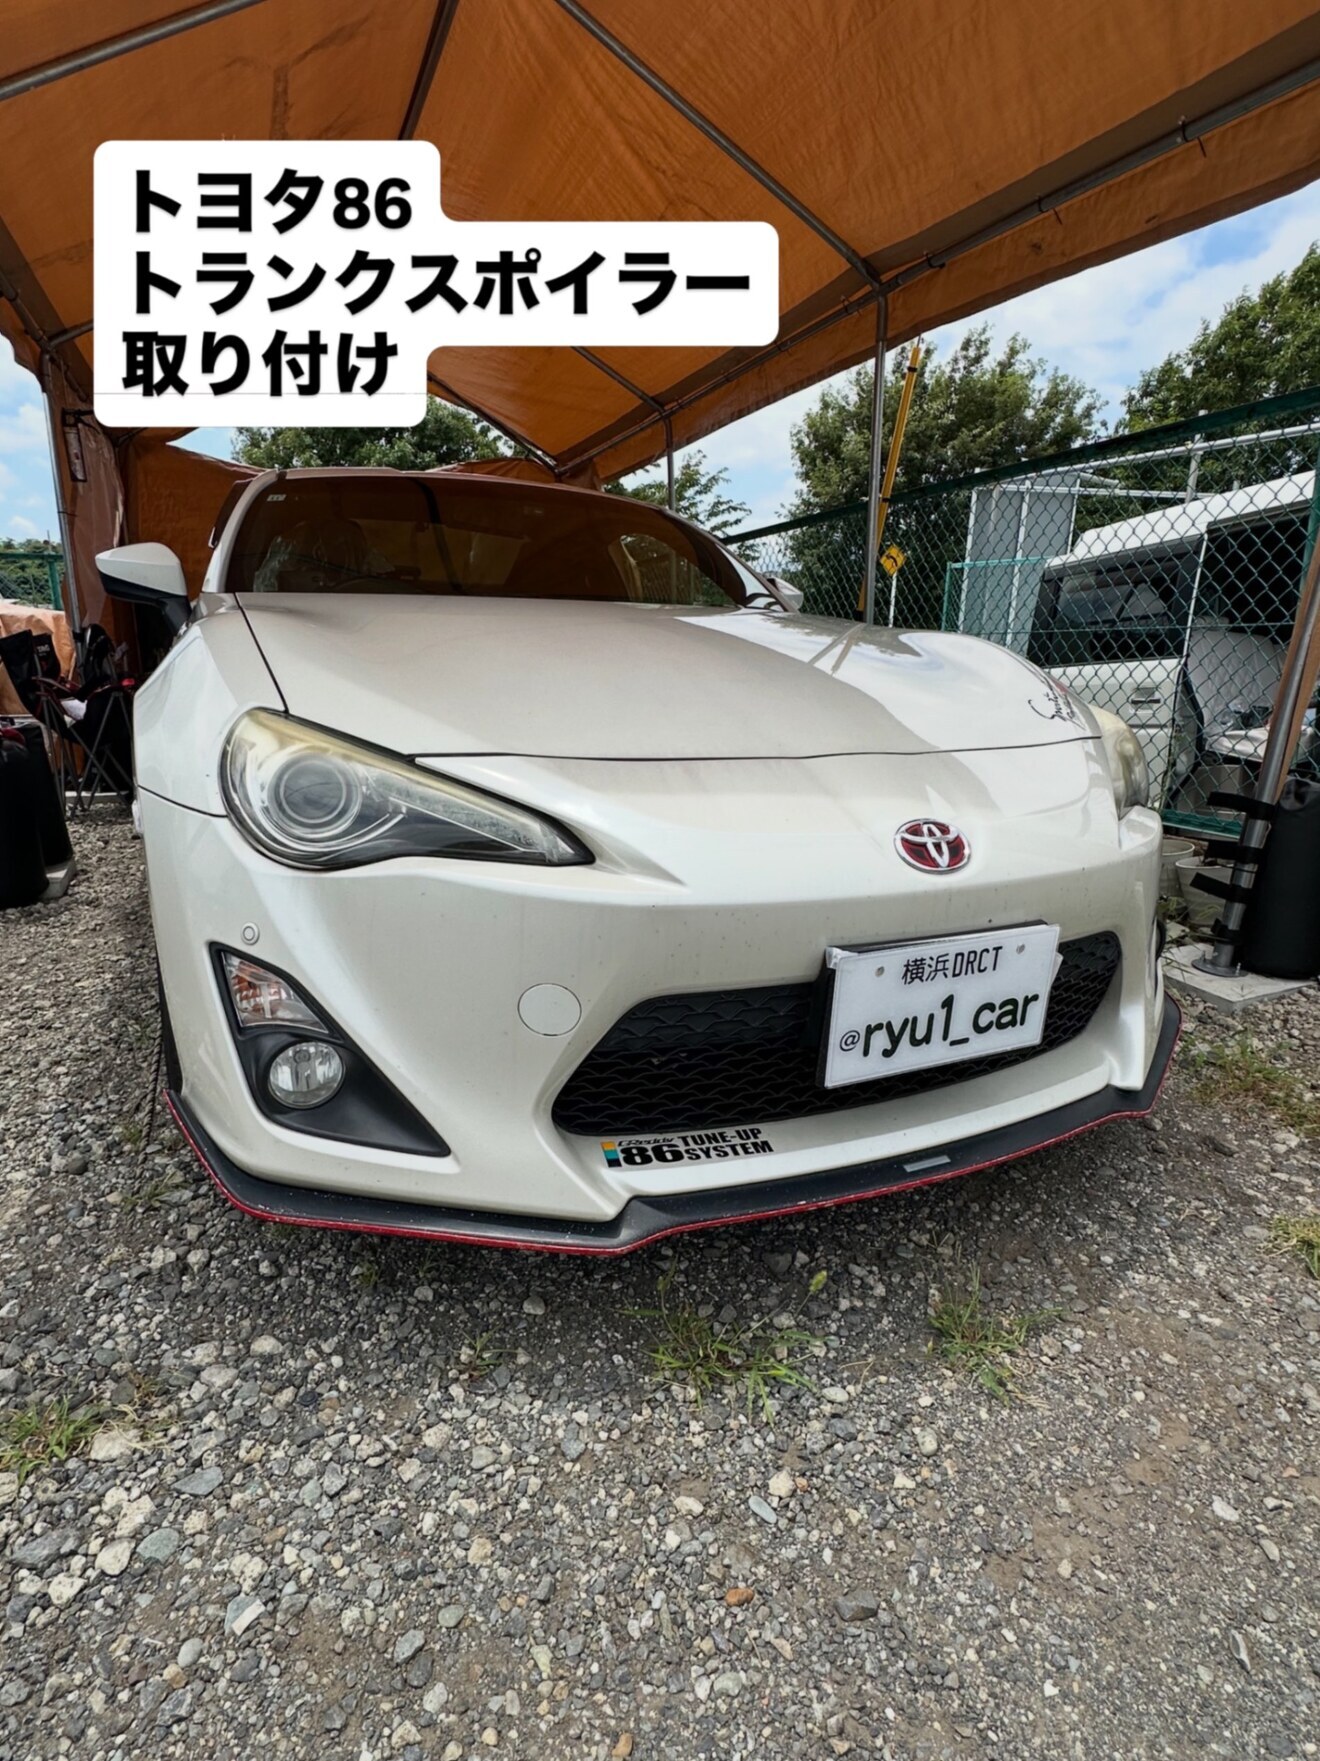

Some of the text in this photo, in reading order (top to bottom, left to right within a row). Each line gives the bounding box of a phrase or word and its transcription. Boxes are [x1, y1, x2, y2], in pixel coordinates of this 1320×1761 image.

[901, 946, 1003, 985] 横浜DRCT
[839, 994, 1040, 1058] @ryu1_car
[620, 1140, 775, 1166] 86 SYSTEM
[677, 1128, 762, 1147] TUNE-UP
